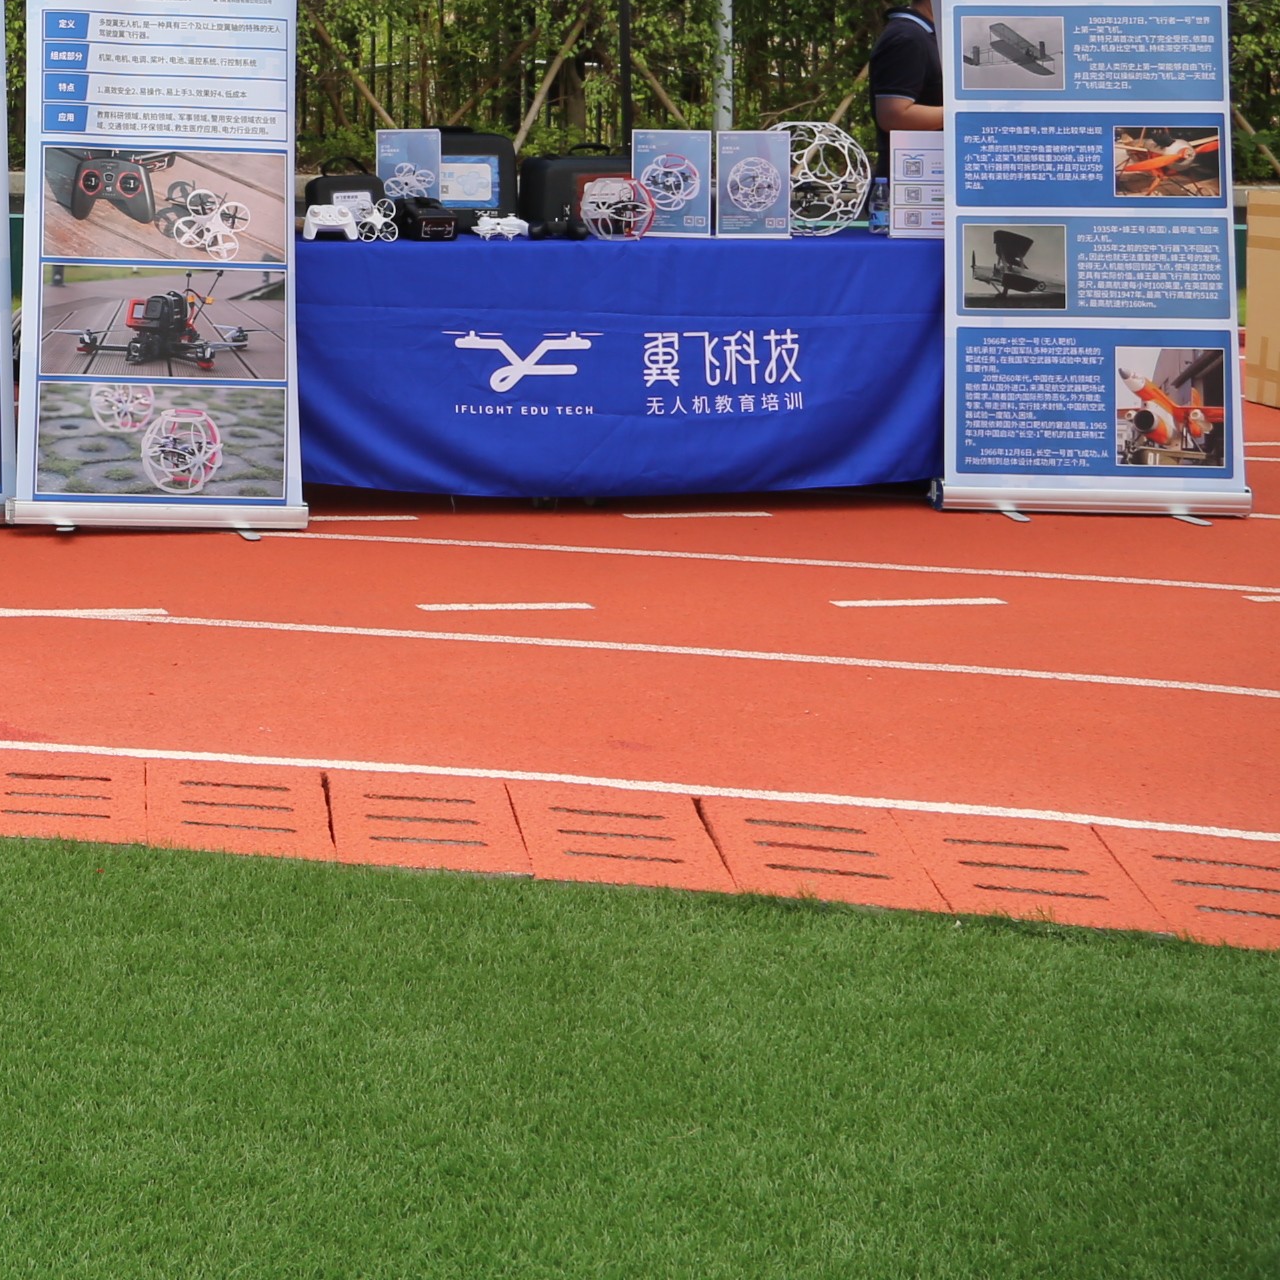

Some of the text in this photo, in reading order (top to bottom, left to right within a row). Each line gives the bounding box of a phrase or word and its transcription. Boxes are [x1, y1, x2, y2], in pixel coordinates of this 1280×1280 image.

[59, 20, 75, 29] 定义
[50, 51, 83, 61] 组成部分
[59, 83, 75, 92] 特点
[58, 112, 74, 122] 应用
[643, 329, 802, 387] 翼飞科技
[646, 391, 804, 416] 无人机教育培训
[455, 405, 594, 415] IFLIGHT EDU TECH
